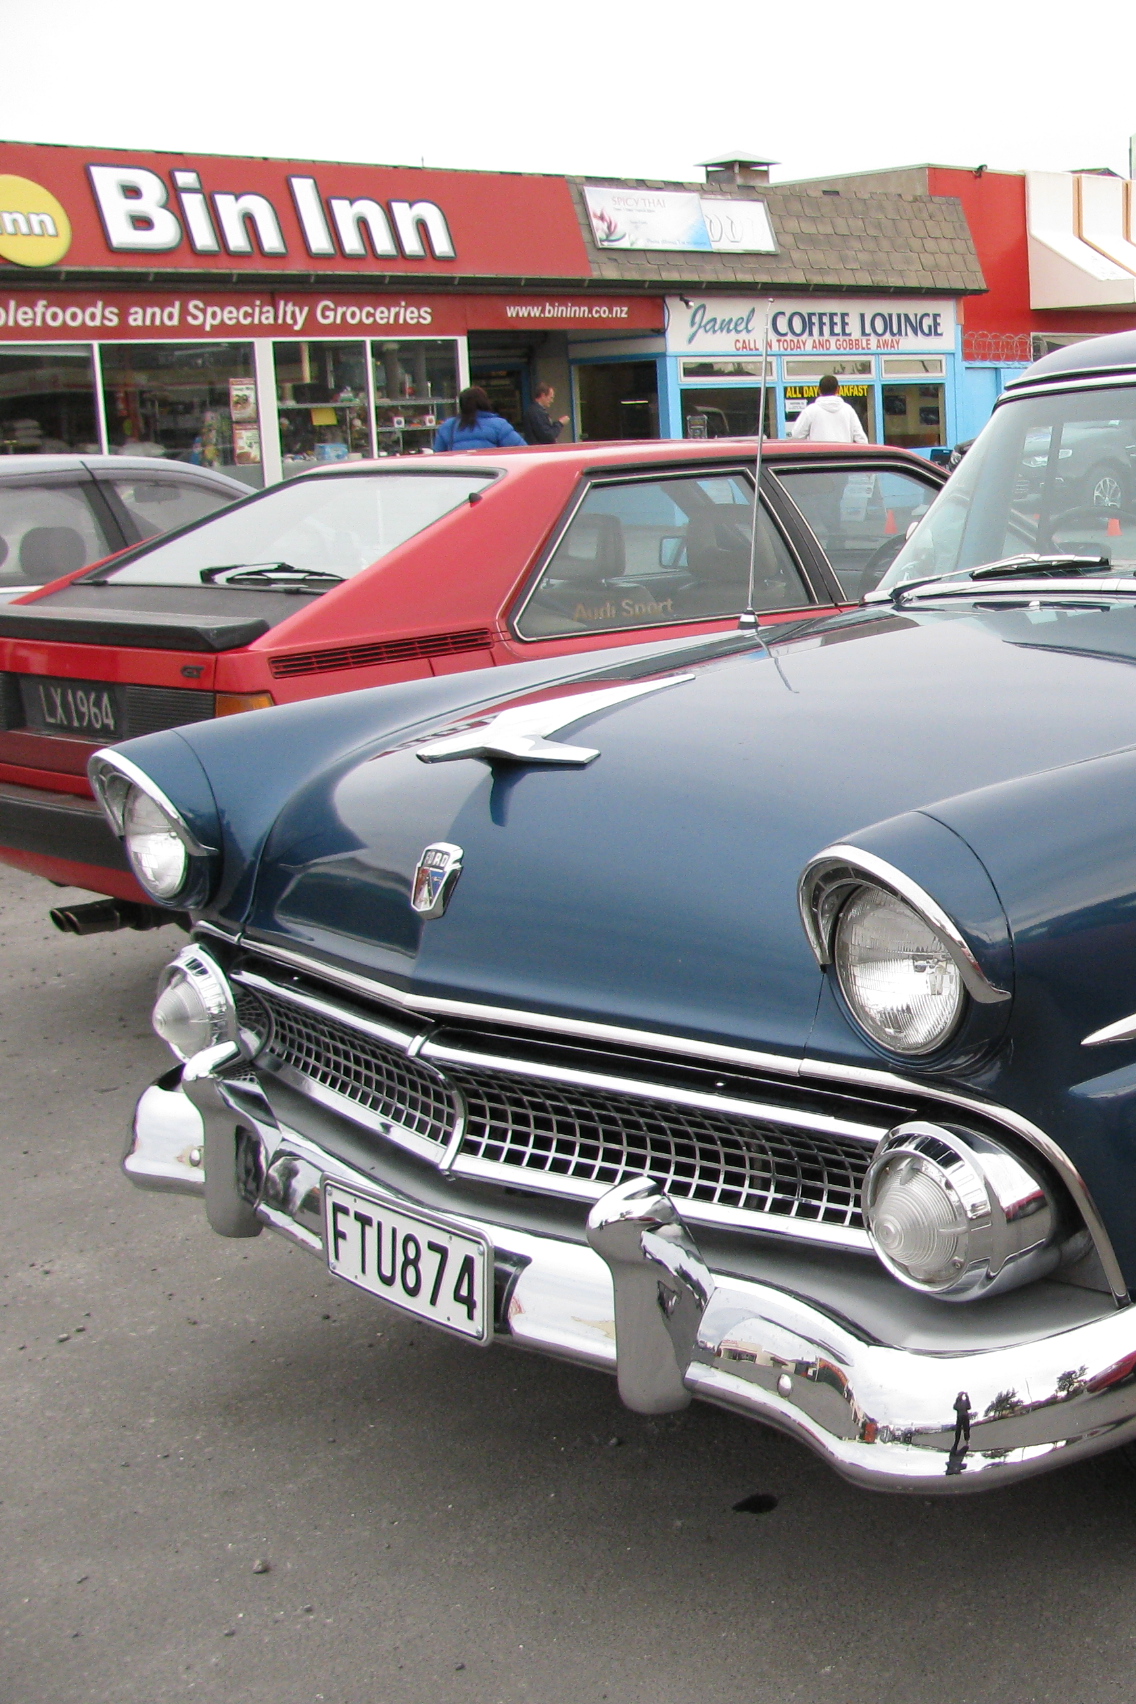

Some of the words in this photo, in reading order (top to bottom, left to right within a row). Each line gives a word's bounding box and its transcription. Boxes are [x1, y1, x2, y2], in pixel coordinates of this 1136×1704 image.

[0, 210, 59, 237] nn
[86, 164, 288, 256] Bin
[288, 175, 456, 260] Inn
[128, 301, 180, 326] and
[187, 300, 309, 331] Specialty
[315, 301, 433, 326] Groceries
[506, 302, 629, 319] www.bininn.co.nz
[687, 303, 756, 345] Janel
[772, 311, 853, 338] COFFEE
[860, 312, 944, 337] LOUNGE
[734, 338, 760, 351] CALL
[776, 338, 808, 351] TODAY
[812, 339, 831, 351] AND
[835, 338, 871, 350] GOBBLE
[876, 338, 901, 350] AWAY
[786, 386, 802, 398] ALL
[573, 603, 616, 622] Audi
[622, 598, 674, 619] Sport
[39, 684, 116, 731] LX1964
[425, 851, 449, 868] FORD
[332, 1200, 477, 1321] FTU874
